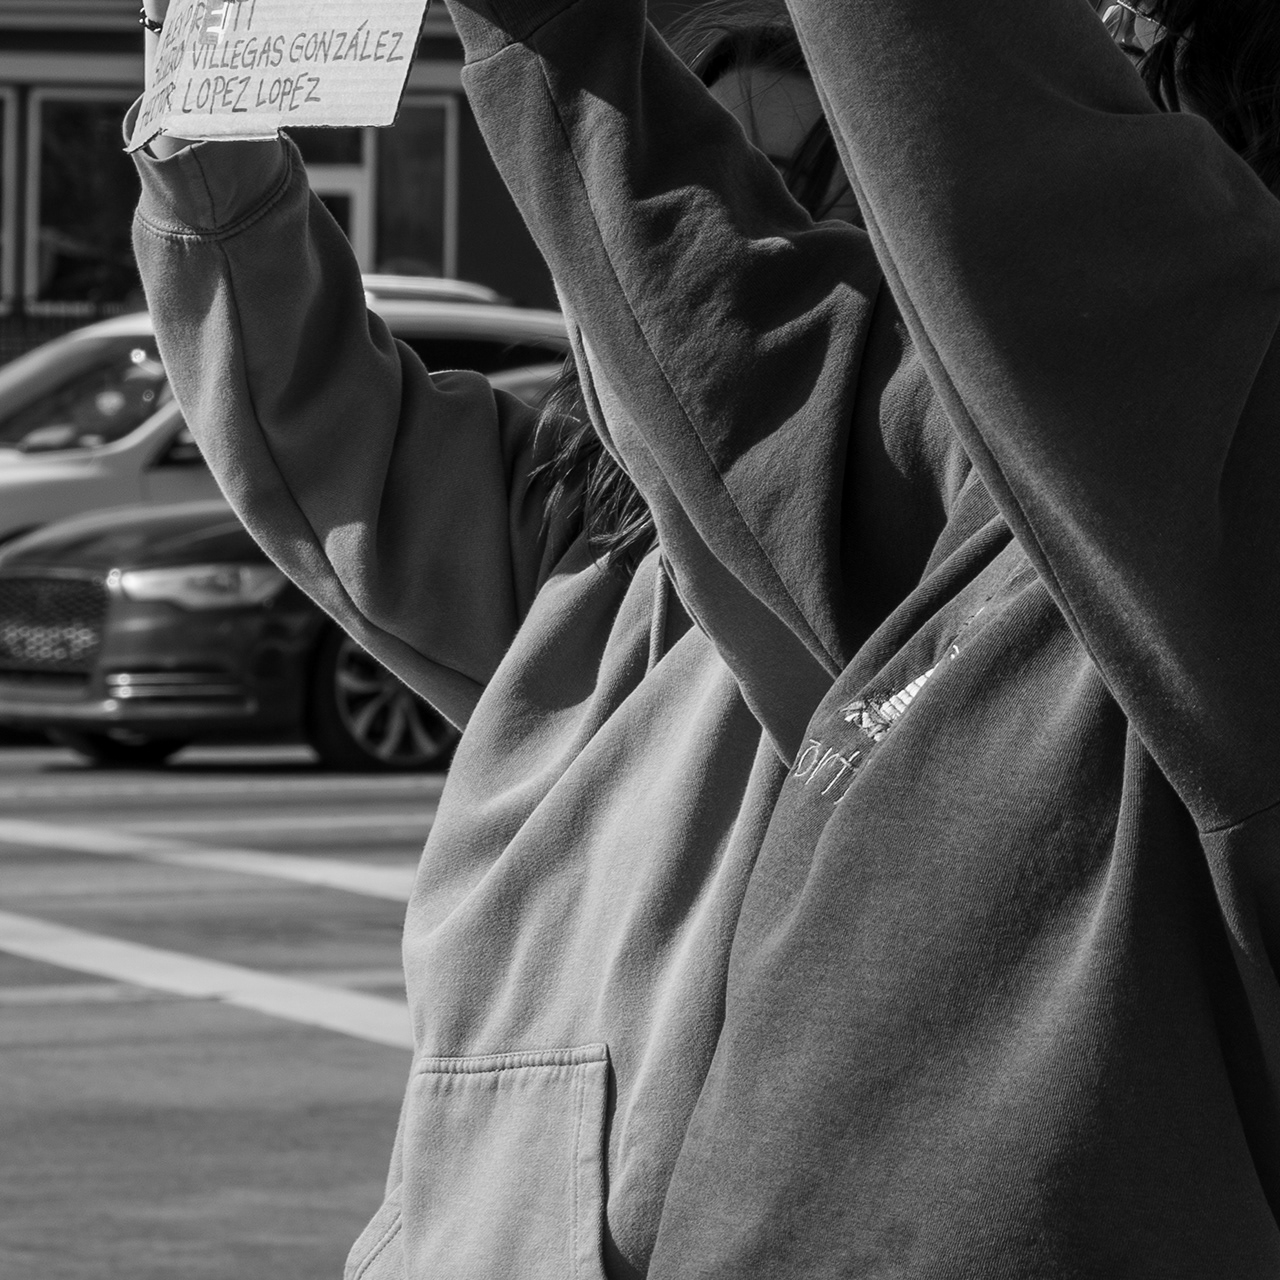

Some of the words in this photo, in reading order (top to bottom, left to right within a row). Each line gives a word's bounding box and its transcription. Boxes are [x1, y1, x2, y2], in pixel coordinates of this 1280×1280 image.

[193, 33, 286, 71] VILLEGAS
[182, 74, 251, 115] LOPEZ
[256, 72, 321, 112] LOPEZ
